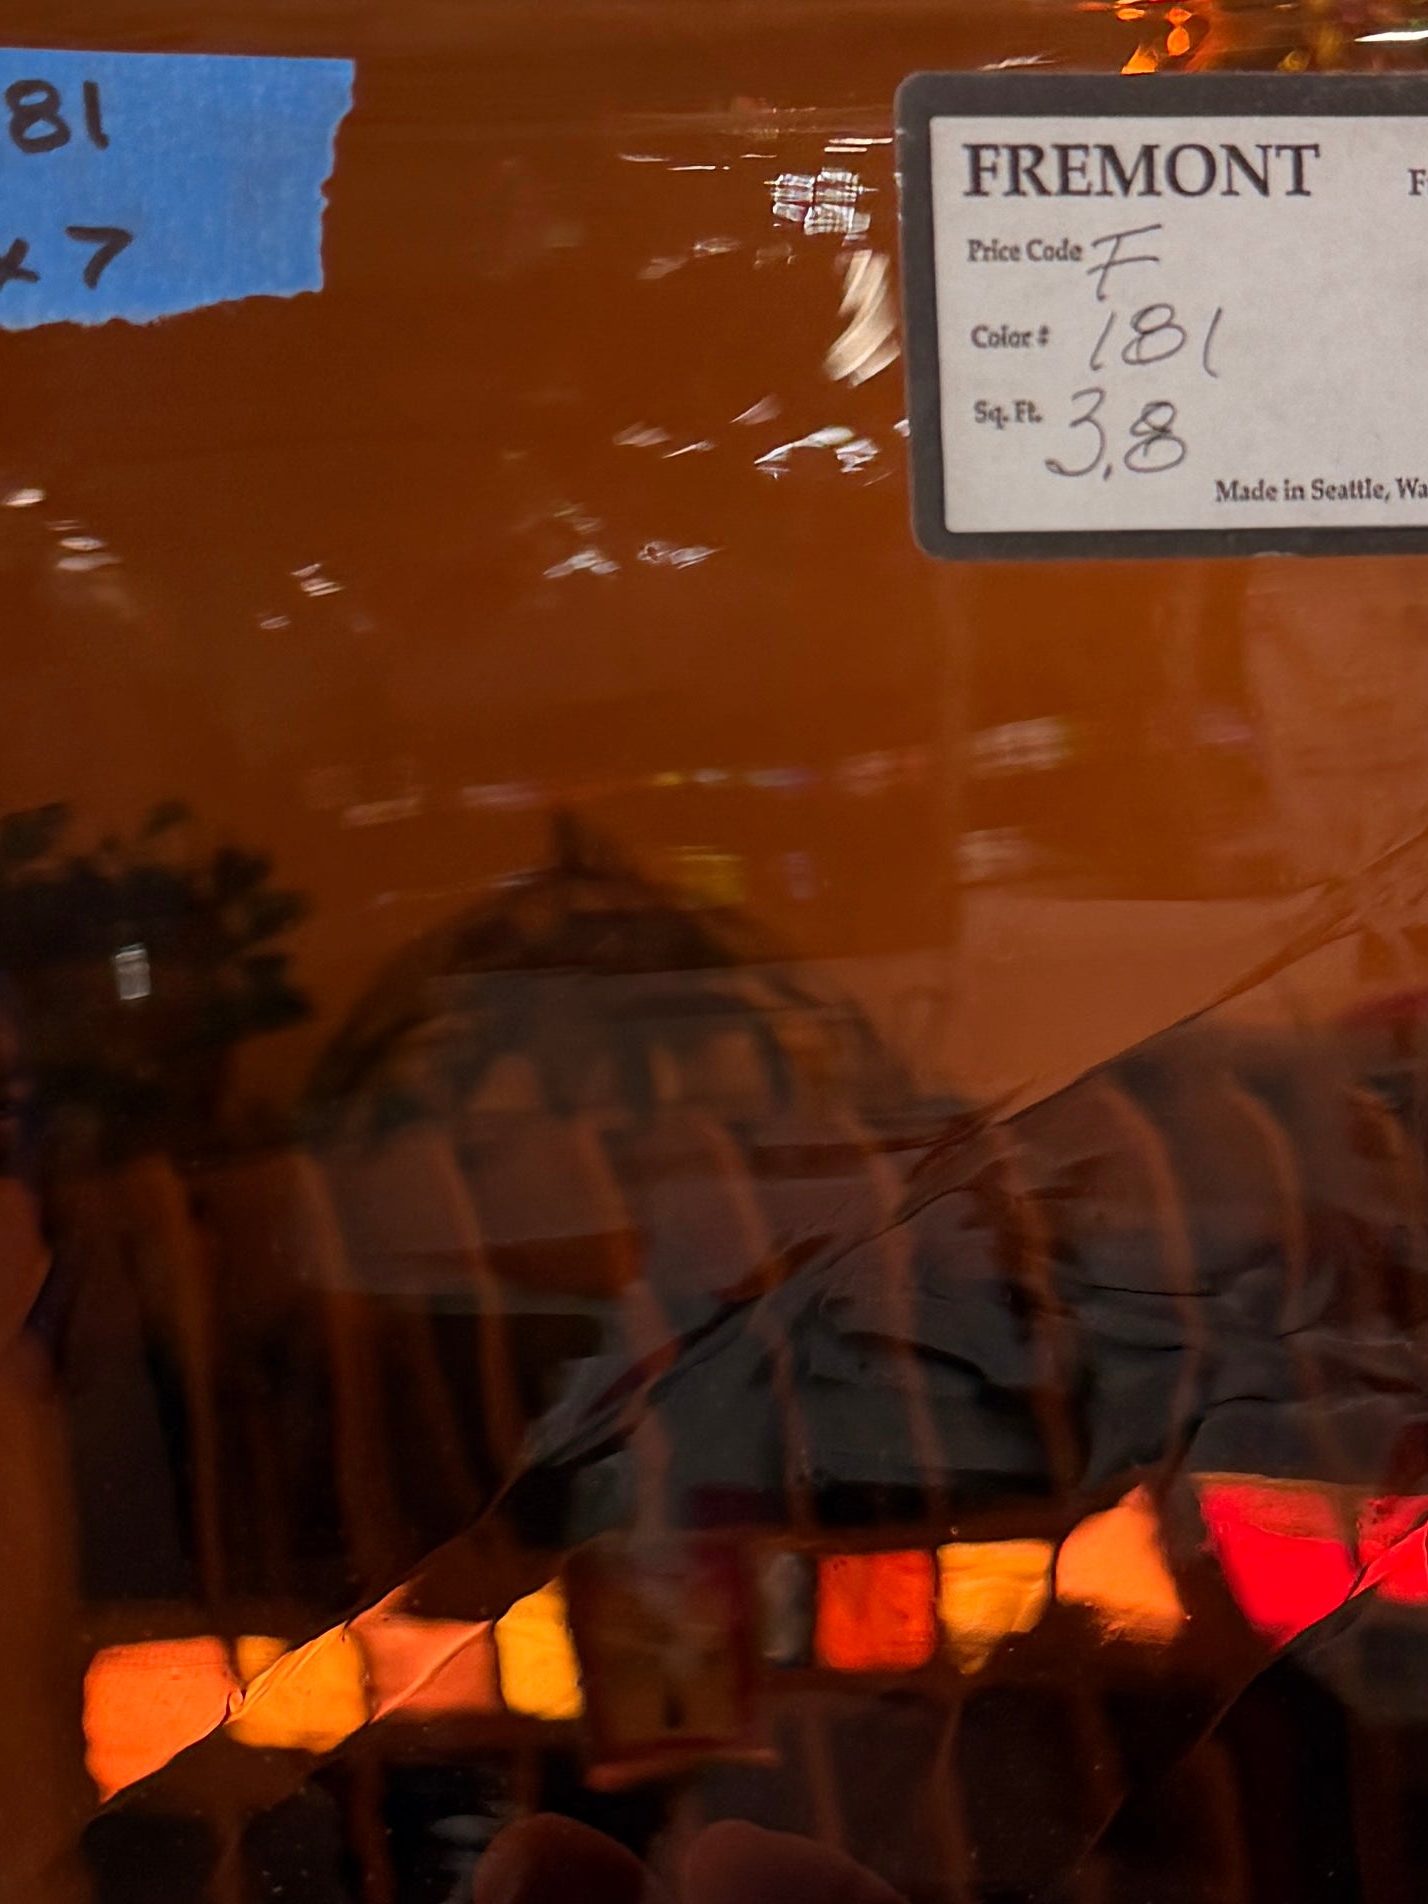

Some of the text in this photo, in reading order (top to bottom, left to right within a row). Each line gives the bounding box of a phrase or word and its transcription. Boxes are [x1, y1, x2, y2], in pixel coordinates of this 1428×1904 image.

[962, 143, 1321, 198] FREMONT
[967, 223, 1162, 302] Price Code F
[970, 324, 1033, 349] Color
[1089, 302, 1223, 378] 181
[973, 399, 1010, 431] Sq.
[1014, 399, 1044, 424] Ft.
[1215, 478, 1279, 503] Made
[1283, 478, 1306, 501] in
[1311, 477, 1391, 502] Seattle,
